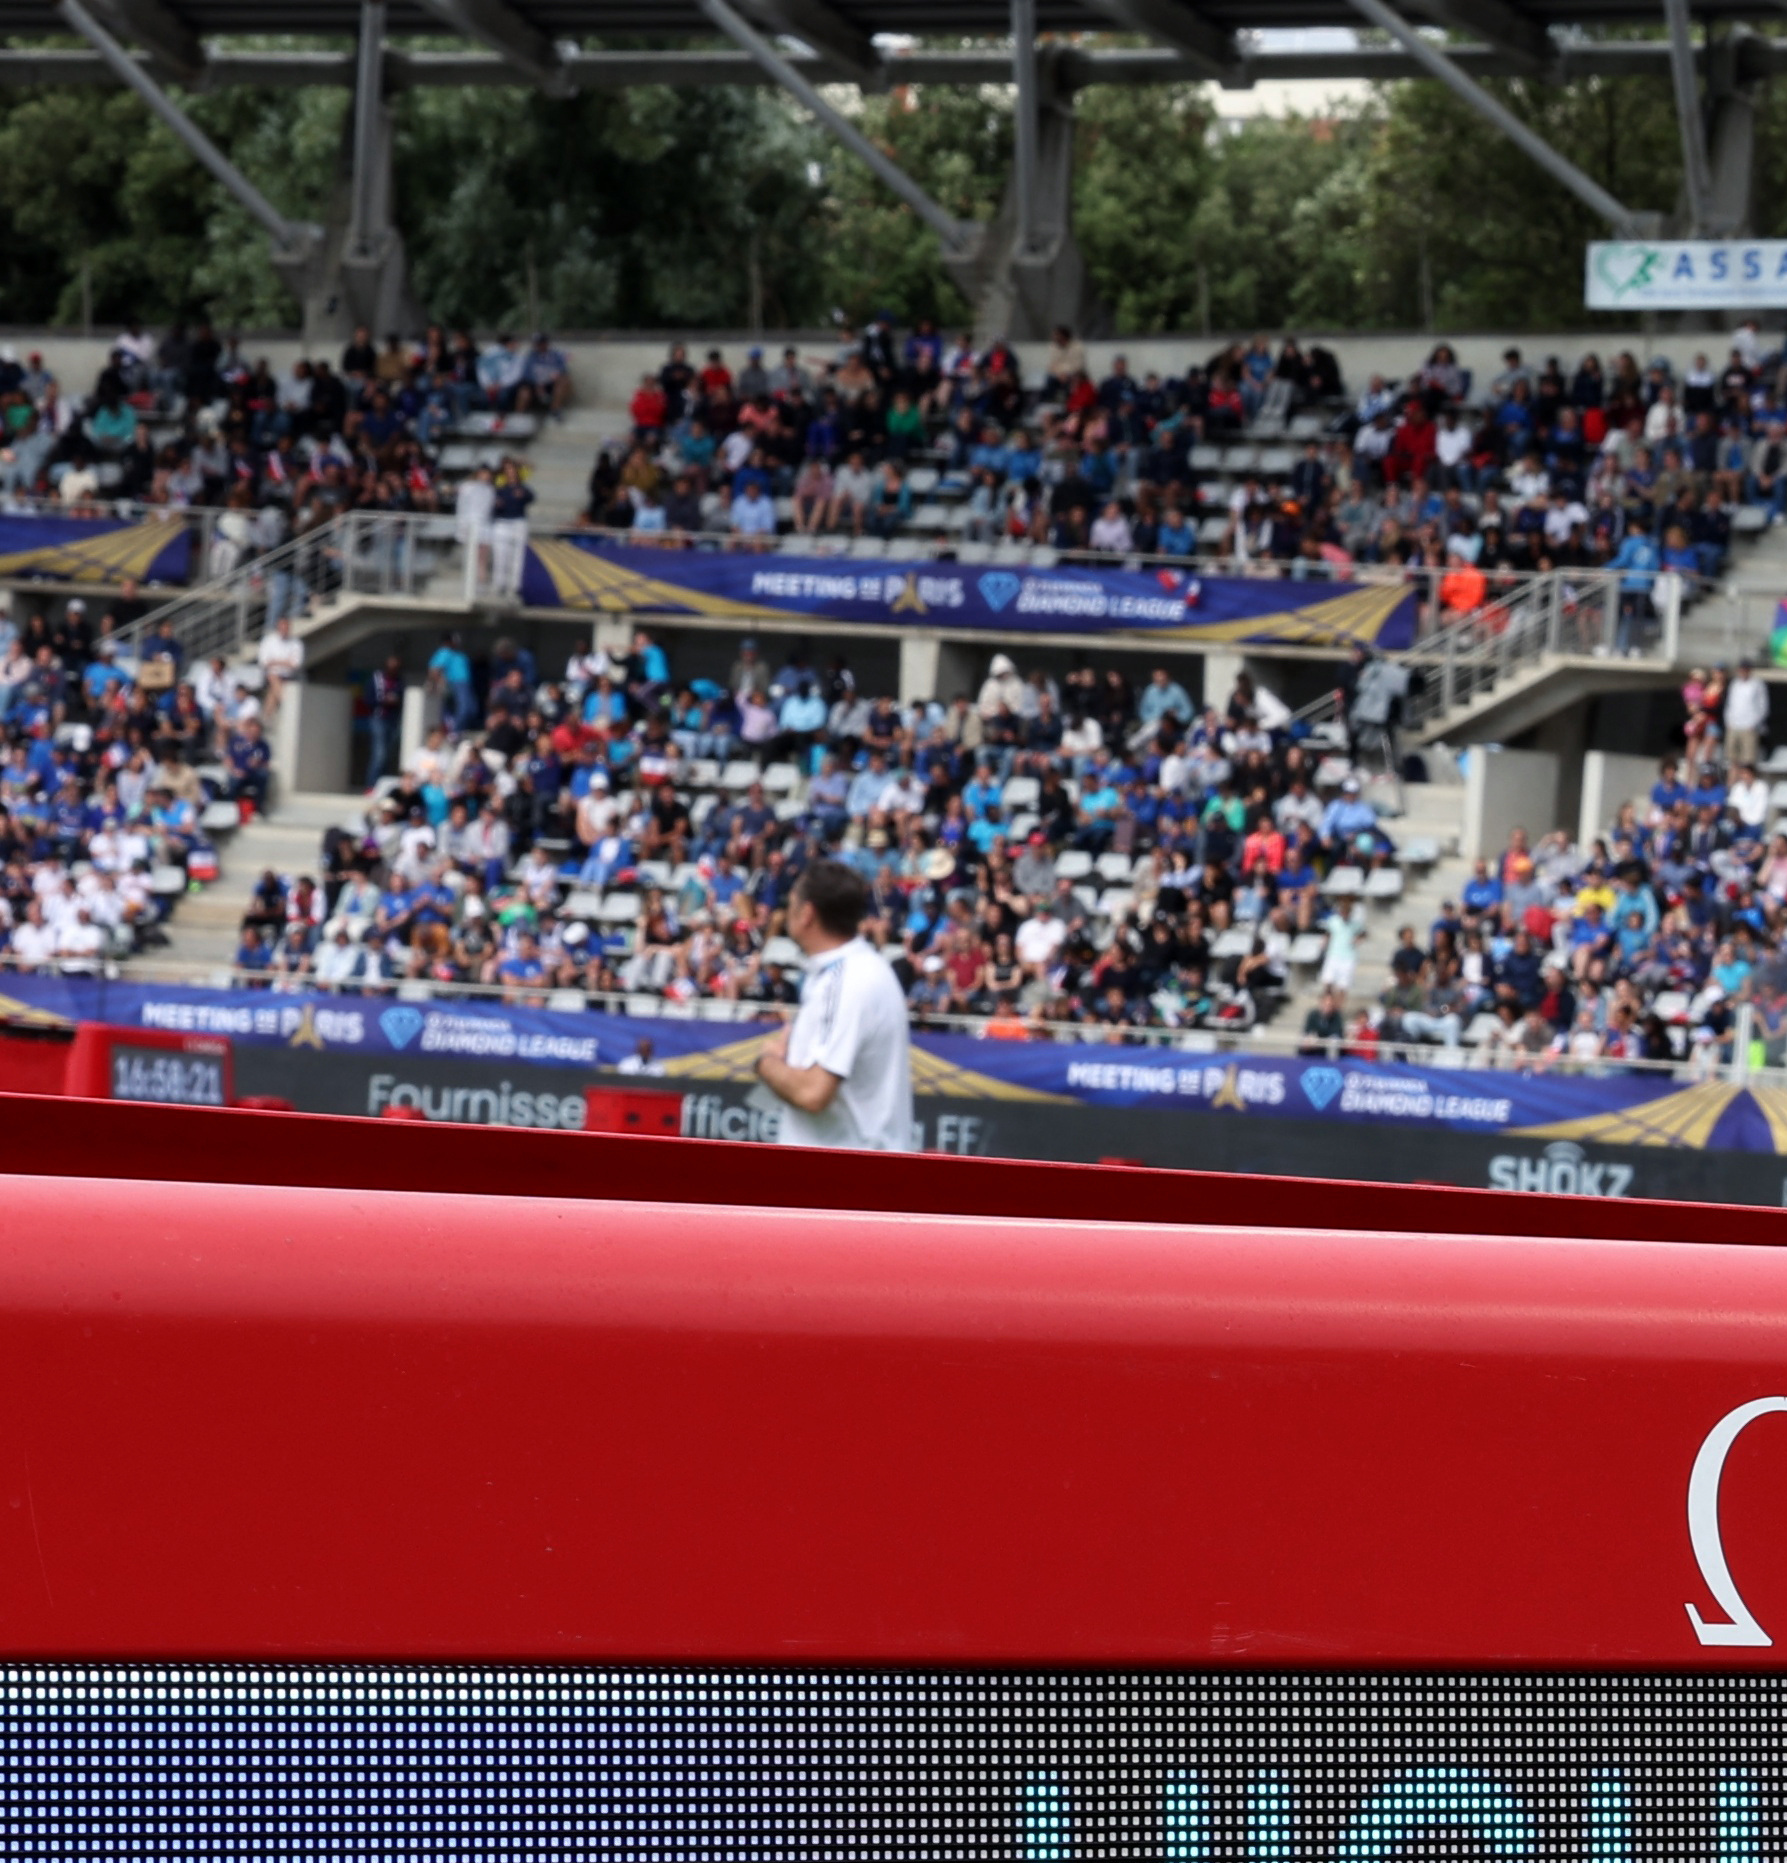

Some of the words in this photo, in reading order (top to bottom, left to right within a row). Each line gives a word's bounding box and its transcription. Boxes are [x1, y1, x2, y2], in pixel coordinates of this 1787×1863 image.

[751, 571, 857, 600] MEETING
[1108, 594, 1187, 621] LEAGUE
[142, 1002, 252, 1033] MEETING
[421, 1029, 517, 1056] DIAMOND
[518, 1034, 598, 1061] LEAGUE
[1067, 1062, 1176, 1094] MEETING
[368, 1073, 587, 1129] Fournisse
[681, 1093, 781, 1142] fficie
[1340, 1088, 1433, 1117] DIAMOND
[1434, 1095, 1511, 1122] LEAGUE
[1488, 1155, 1634, 1198] SHOKZ
